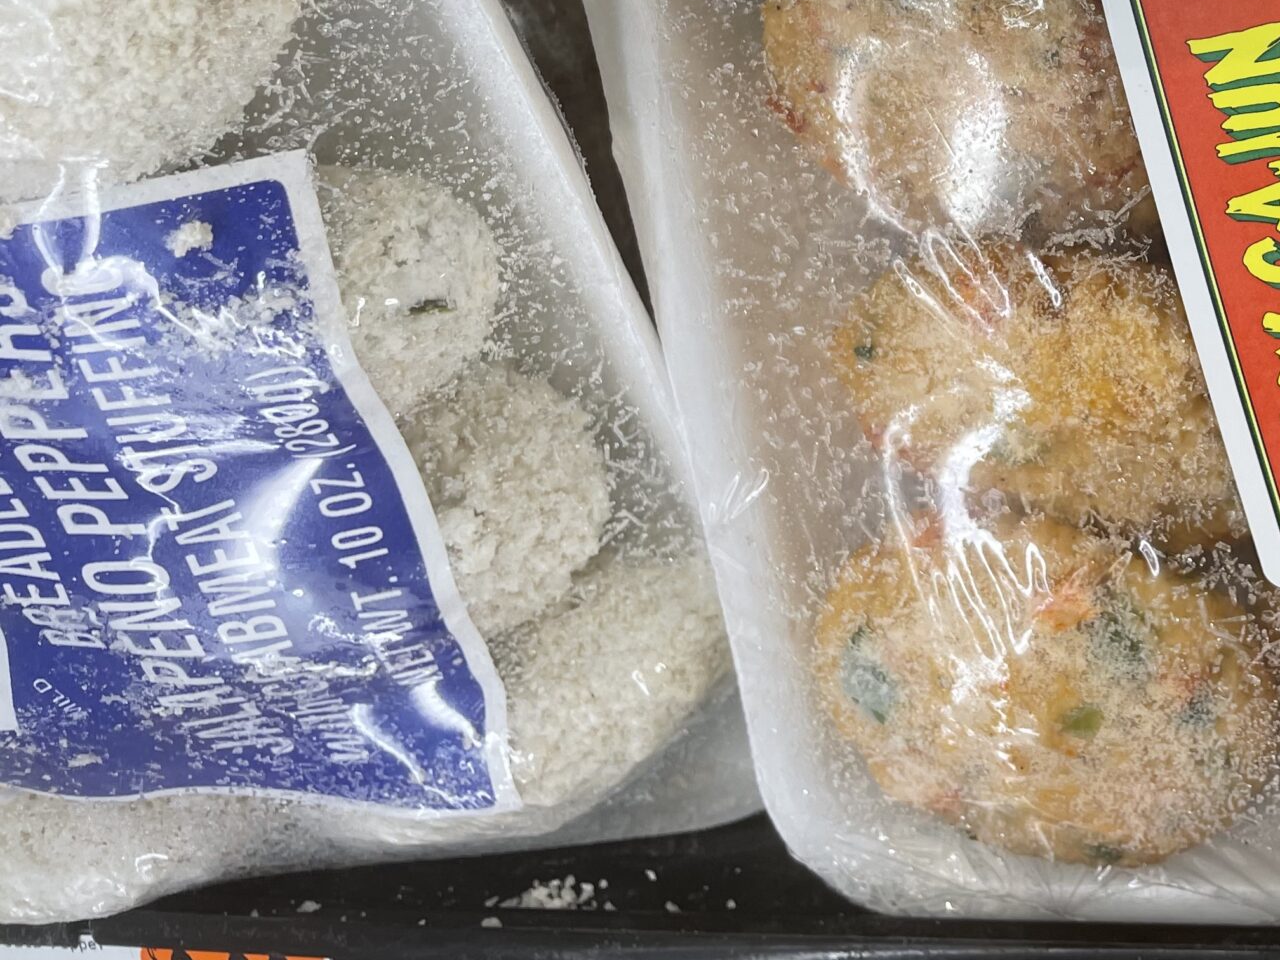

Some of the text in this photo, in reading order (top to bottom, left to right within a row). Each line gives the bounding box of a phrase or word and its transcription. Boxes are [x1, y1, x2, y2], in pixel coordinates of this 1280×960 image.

[41, 255, 218, 495] STUFFING
[310, 462, 374, 518] OZ.
[0, 478, 107, 648] BREAD
[330, 525, 389, 569] 10
[81, 558, 294, 756] JALAPEÑO
[373, 641, 445, 688] NET
